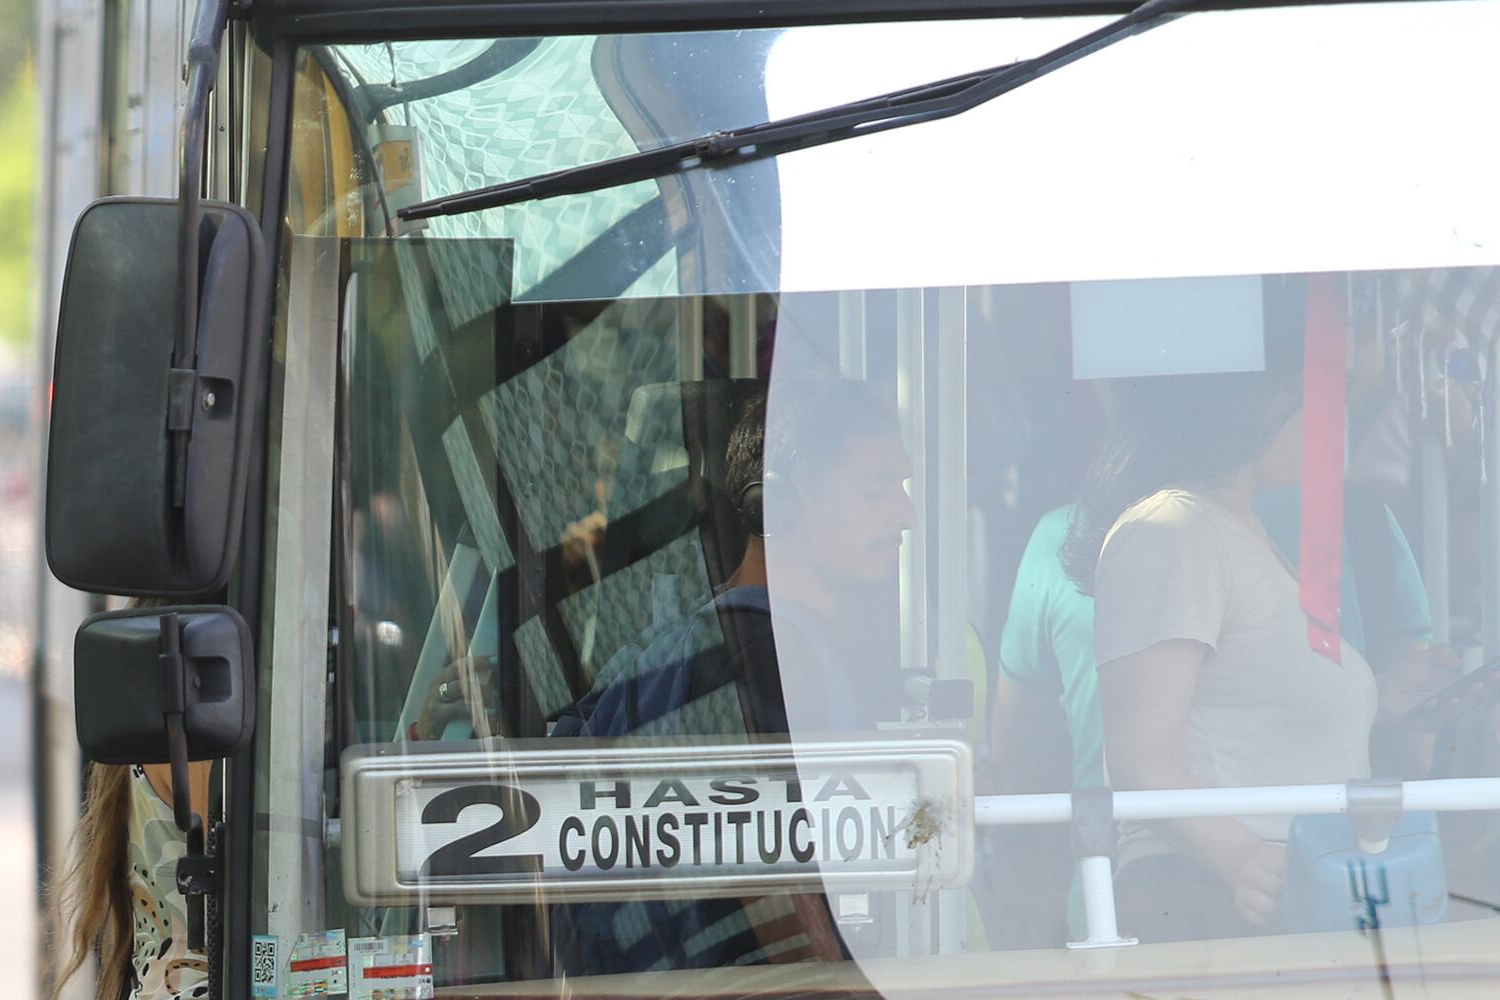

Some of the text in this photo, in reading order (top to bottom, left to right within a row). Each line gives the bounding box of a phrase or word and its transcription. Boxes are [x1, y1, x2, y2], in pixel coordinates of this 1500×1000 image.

[579, 773, 872, 810] HASTA
[419, 784, 545, 876] 2
[558, 805, 897, 872] CONSTITUCION
